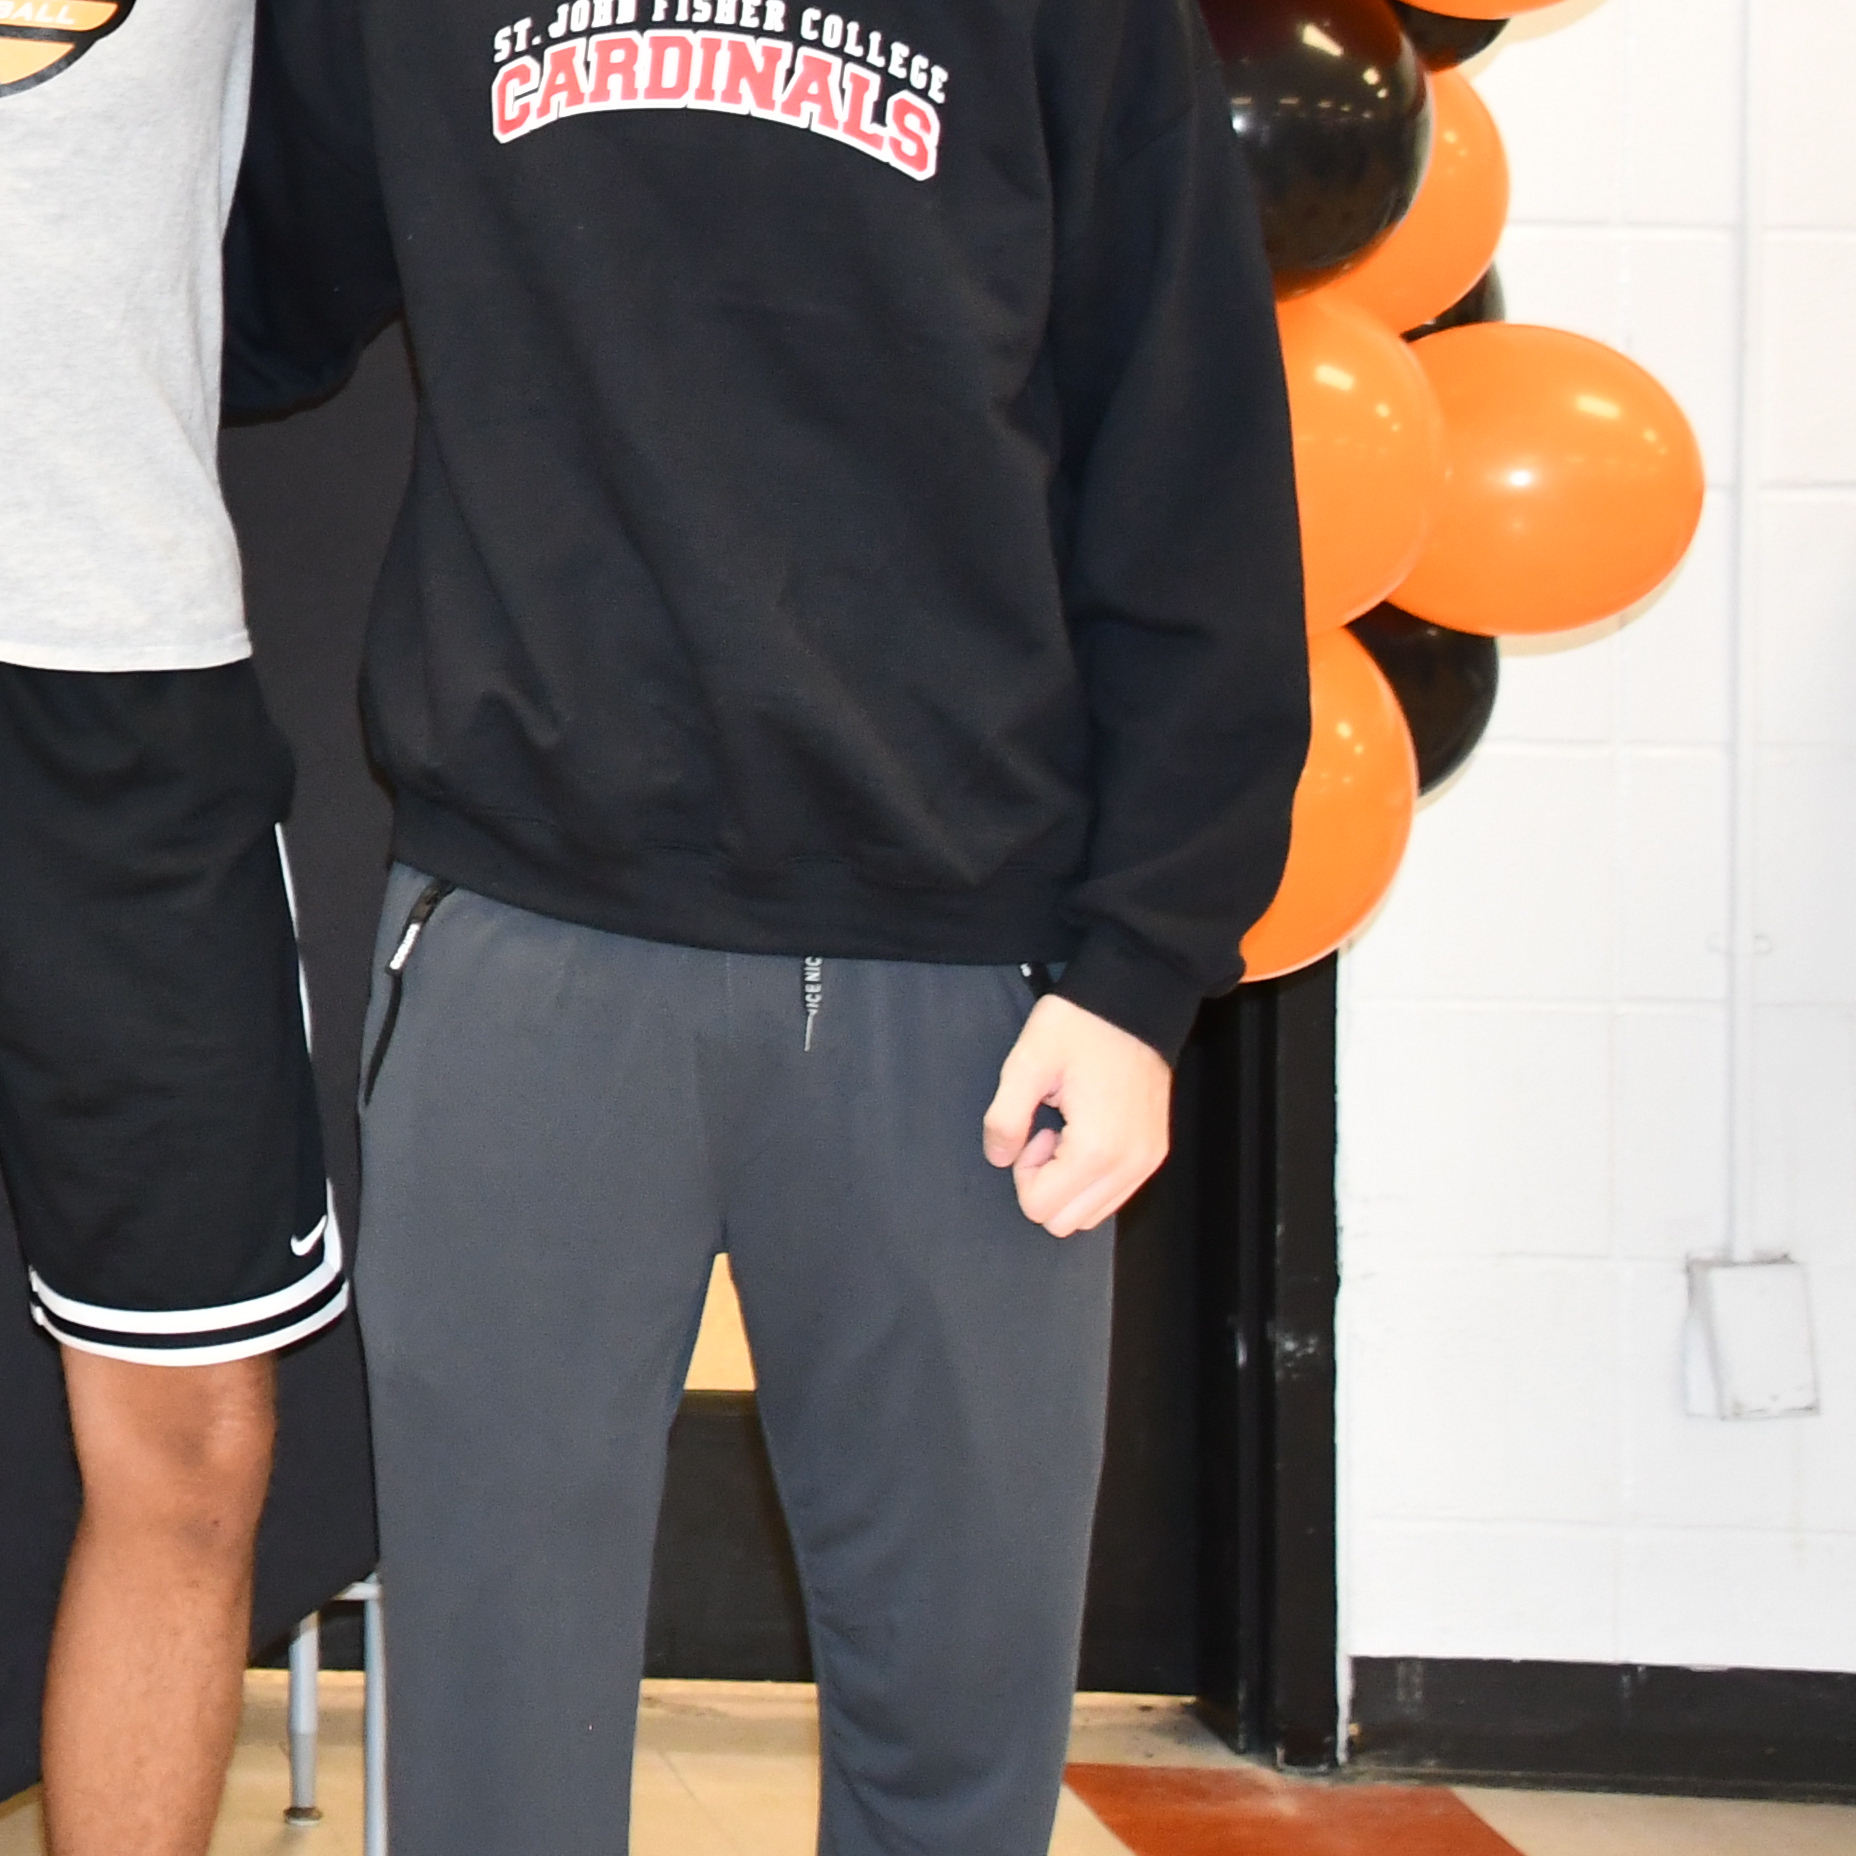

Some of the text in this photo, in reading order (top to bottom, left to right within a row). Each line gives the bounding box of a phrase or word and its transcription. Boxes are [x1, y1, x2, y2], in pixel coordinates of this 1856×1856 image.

[491, 28, 942, 182] CARDINALS
[493, 16, 542, 63] ST.
[800, 7, 950, 104] COLLEGE
